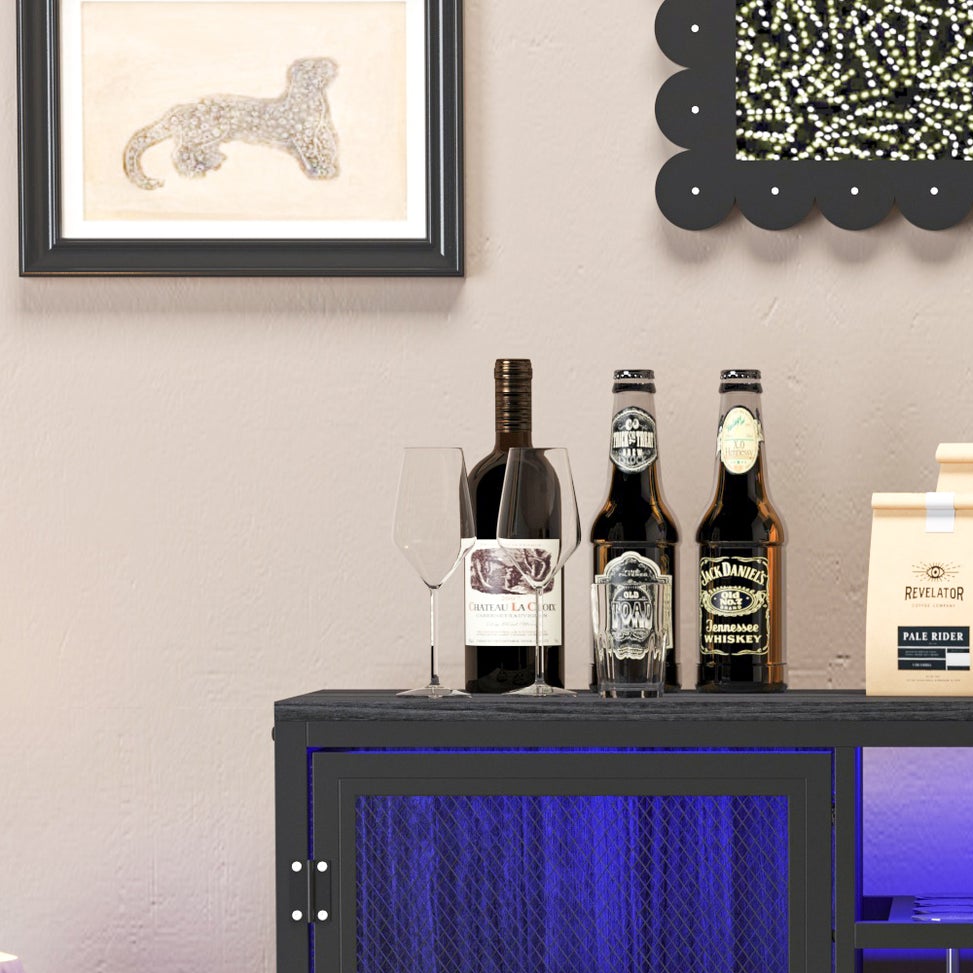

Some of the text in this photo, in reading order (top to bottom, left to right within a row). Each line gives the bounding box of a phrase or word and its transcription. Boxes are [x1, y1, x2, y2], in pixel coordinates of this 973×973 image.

[701, 565, 721, 586] JACK
[623, 591, 640, 599] OLD
[721, 591, 740, 599] Old
[904, 586, 964, 601] REVELATOR
[511, 602, 526, 611] LA
[527, 602, 556, 611] COIX
[704, 634, 762, 644] WHISKEY
[902, 632, 964, 641] PALE RIDER
